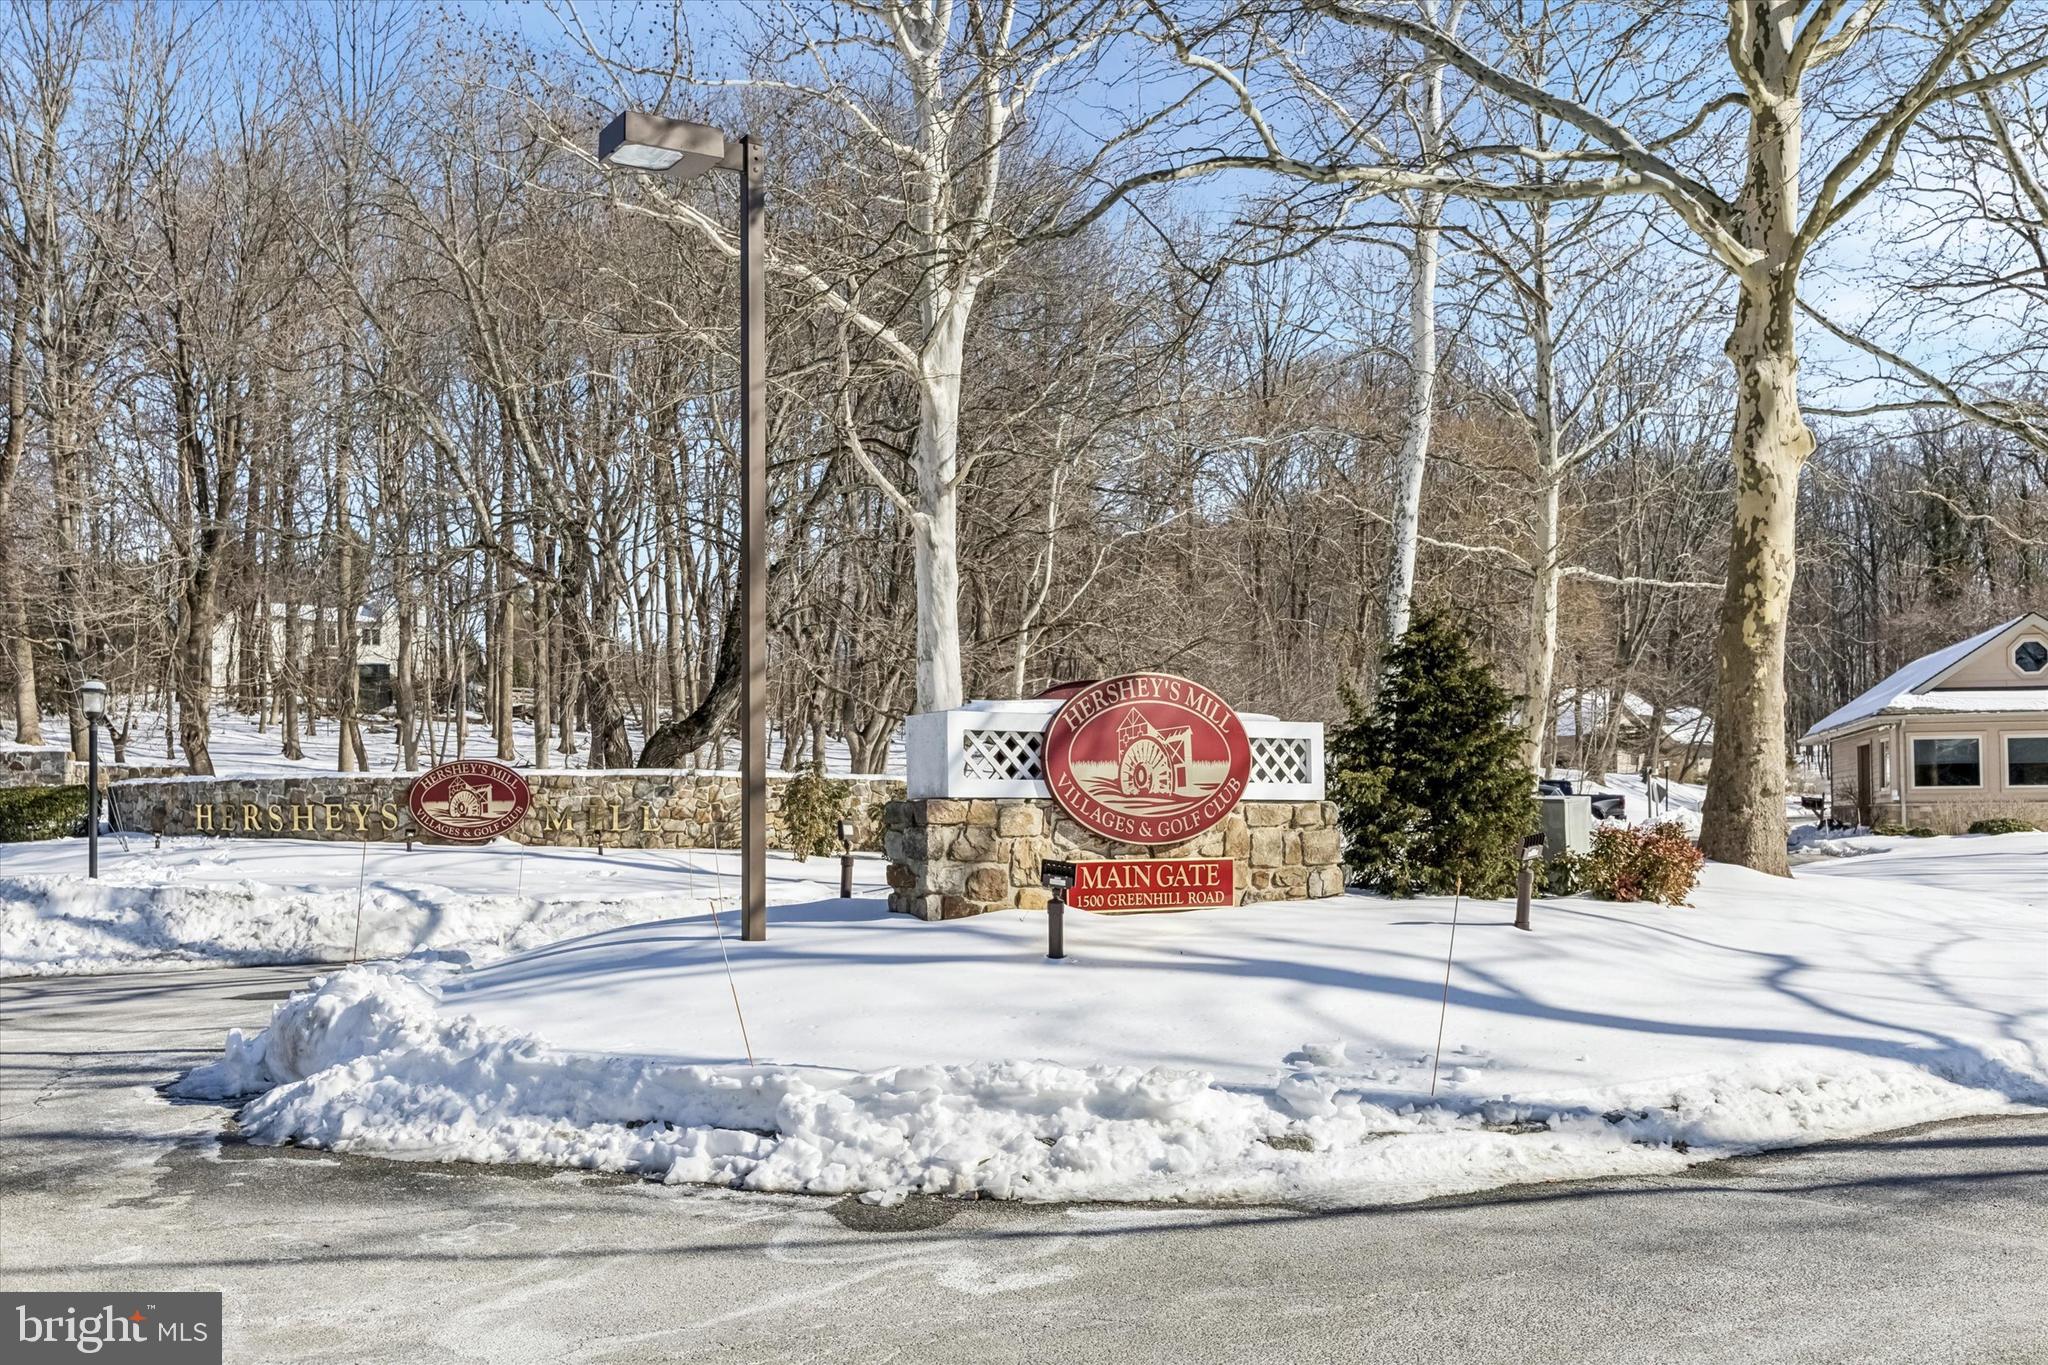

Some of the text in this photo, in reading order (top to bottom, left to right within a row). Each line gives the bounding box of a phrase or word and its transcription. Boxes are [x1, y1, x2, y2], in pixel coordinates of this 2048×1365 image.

[1062, 677, 1233, 733] HERSHEY'S MILL
[420, 763, 519, 790] HERSHEY'S MILL
[195, 803, 662, 832] HERSHEYS MILL
[1057, 772, 1241, 838] VILLAGES & GOLF CLUB
[416, 808, 460, 836] VILLAGES
[473, 823, 500, 837] GOLF
[501, 806, 524, 827] CLUB
[1080, 864, 1221, 890] MAIN GATE
[1077, 890, 1225, 908] 1500 GREENHILL ROAD
